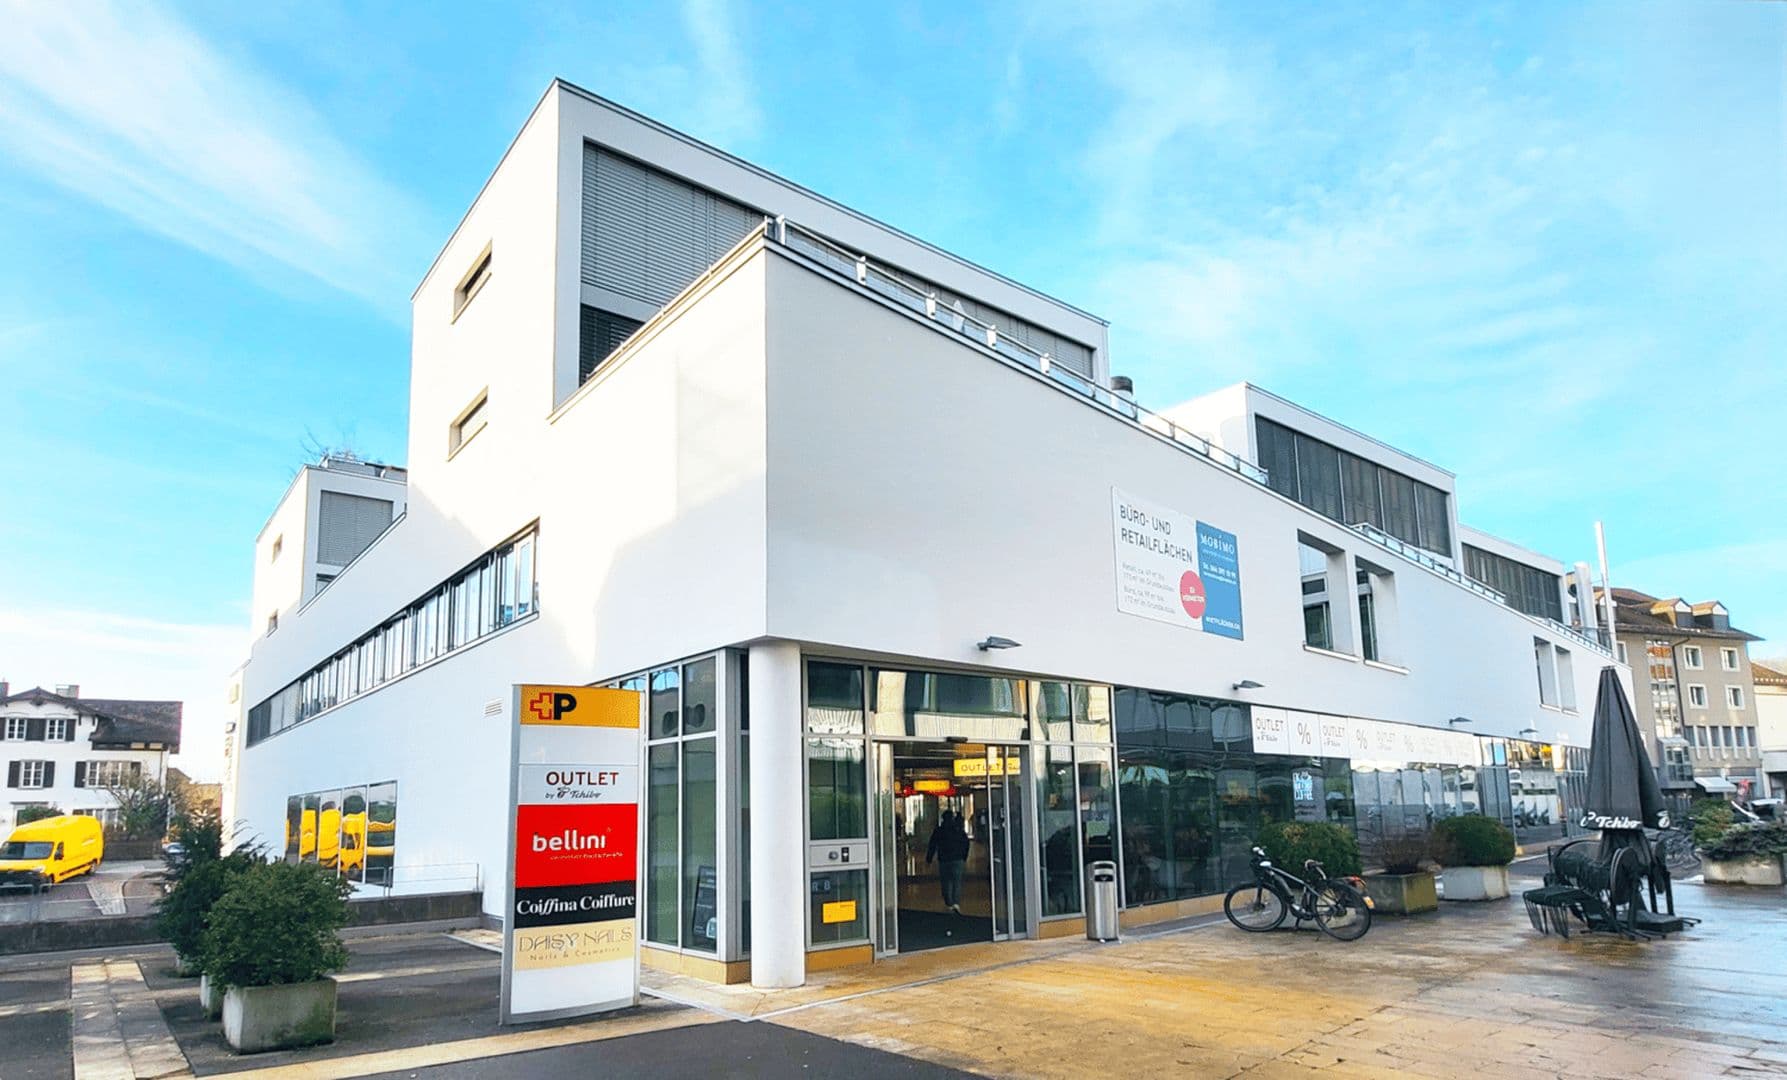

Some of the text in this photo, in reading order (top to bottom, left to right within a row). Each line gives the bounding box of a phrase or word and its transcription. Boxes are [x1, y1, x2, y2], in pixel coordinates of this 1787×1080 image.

[1120, 504, 1171, 535] BÜRO- UND
[1121, 527, 1192, 563] RETAILFLÄCHEN
[1256, 717, 1284, 732] OUTLET
[1323, 725, 1345, 738] OUTLET
[546, 771, 619, 786] OUTLET
[961, 763, 1000, 772] OUTLET
[545, 790, 601, 799] by Tchibo
[1595, 815, 1642, 829] Tchibo
[532, 829, 606, 852] bellini
[517, 893, 635, 916] Coiffina Coiffure
[519, 926, 633, 952] DAISY NAILS
